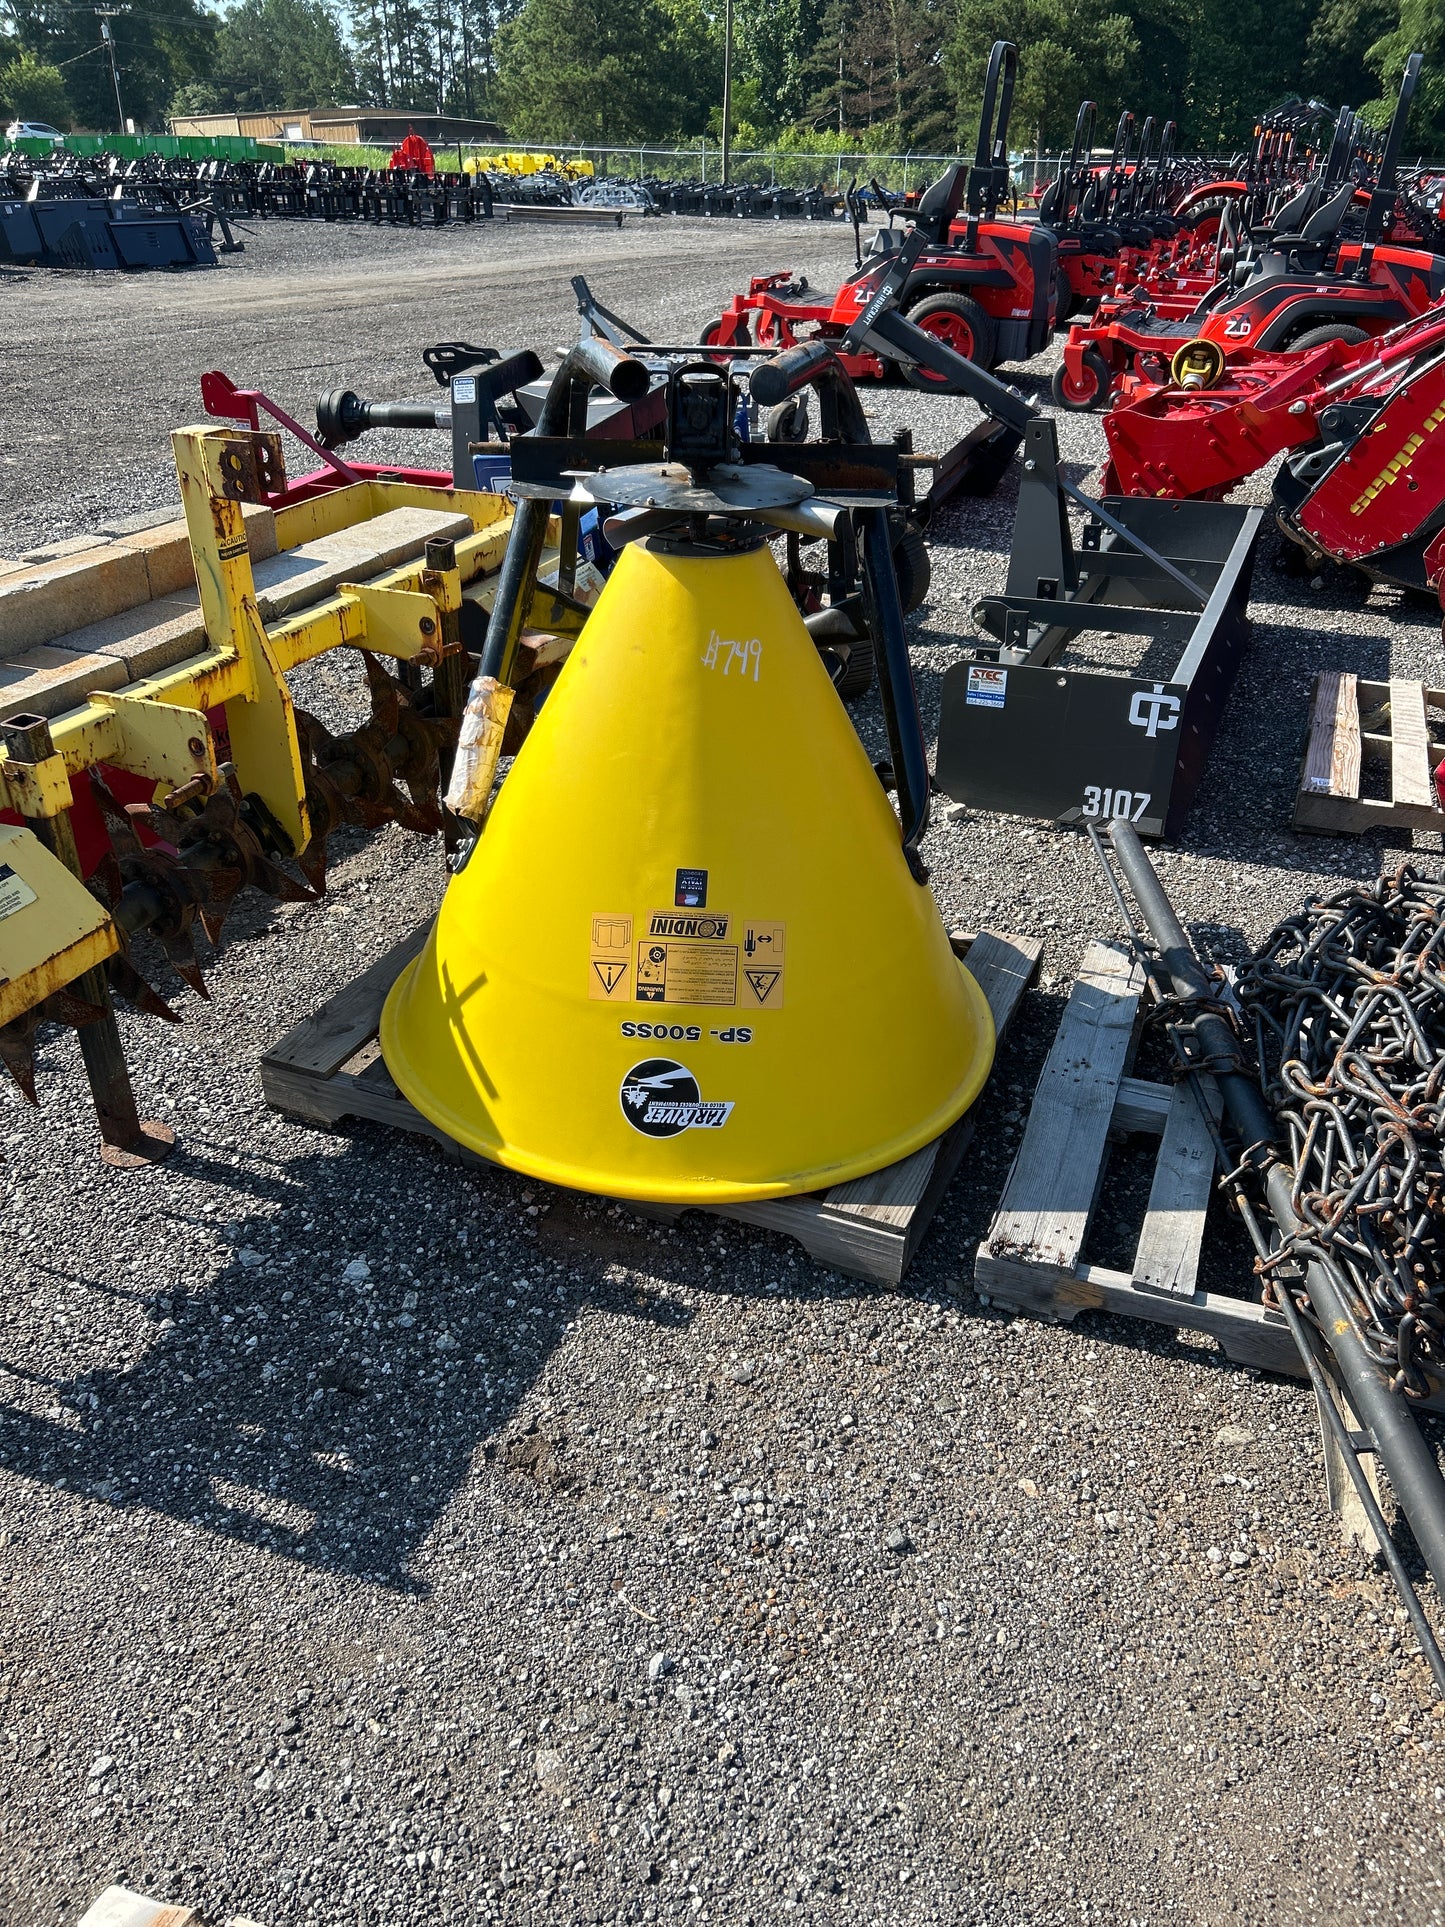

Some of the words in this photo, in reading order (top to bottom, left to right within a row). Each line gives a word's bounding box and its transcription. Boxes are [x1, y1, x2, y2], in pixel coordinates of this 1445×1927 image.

[700, 629, 763, 682] #749
[971, 669, 1003, 681] STEC
[1082, 785, 1151, 823] 3107
[650, 918, 729, 937] RONDINI
[637, 985, 664, 993] WARNING
[621, 1021, 701, 1041] 500SS
[710, 1027, 752, 1043] SP-
